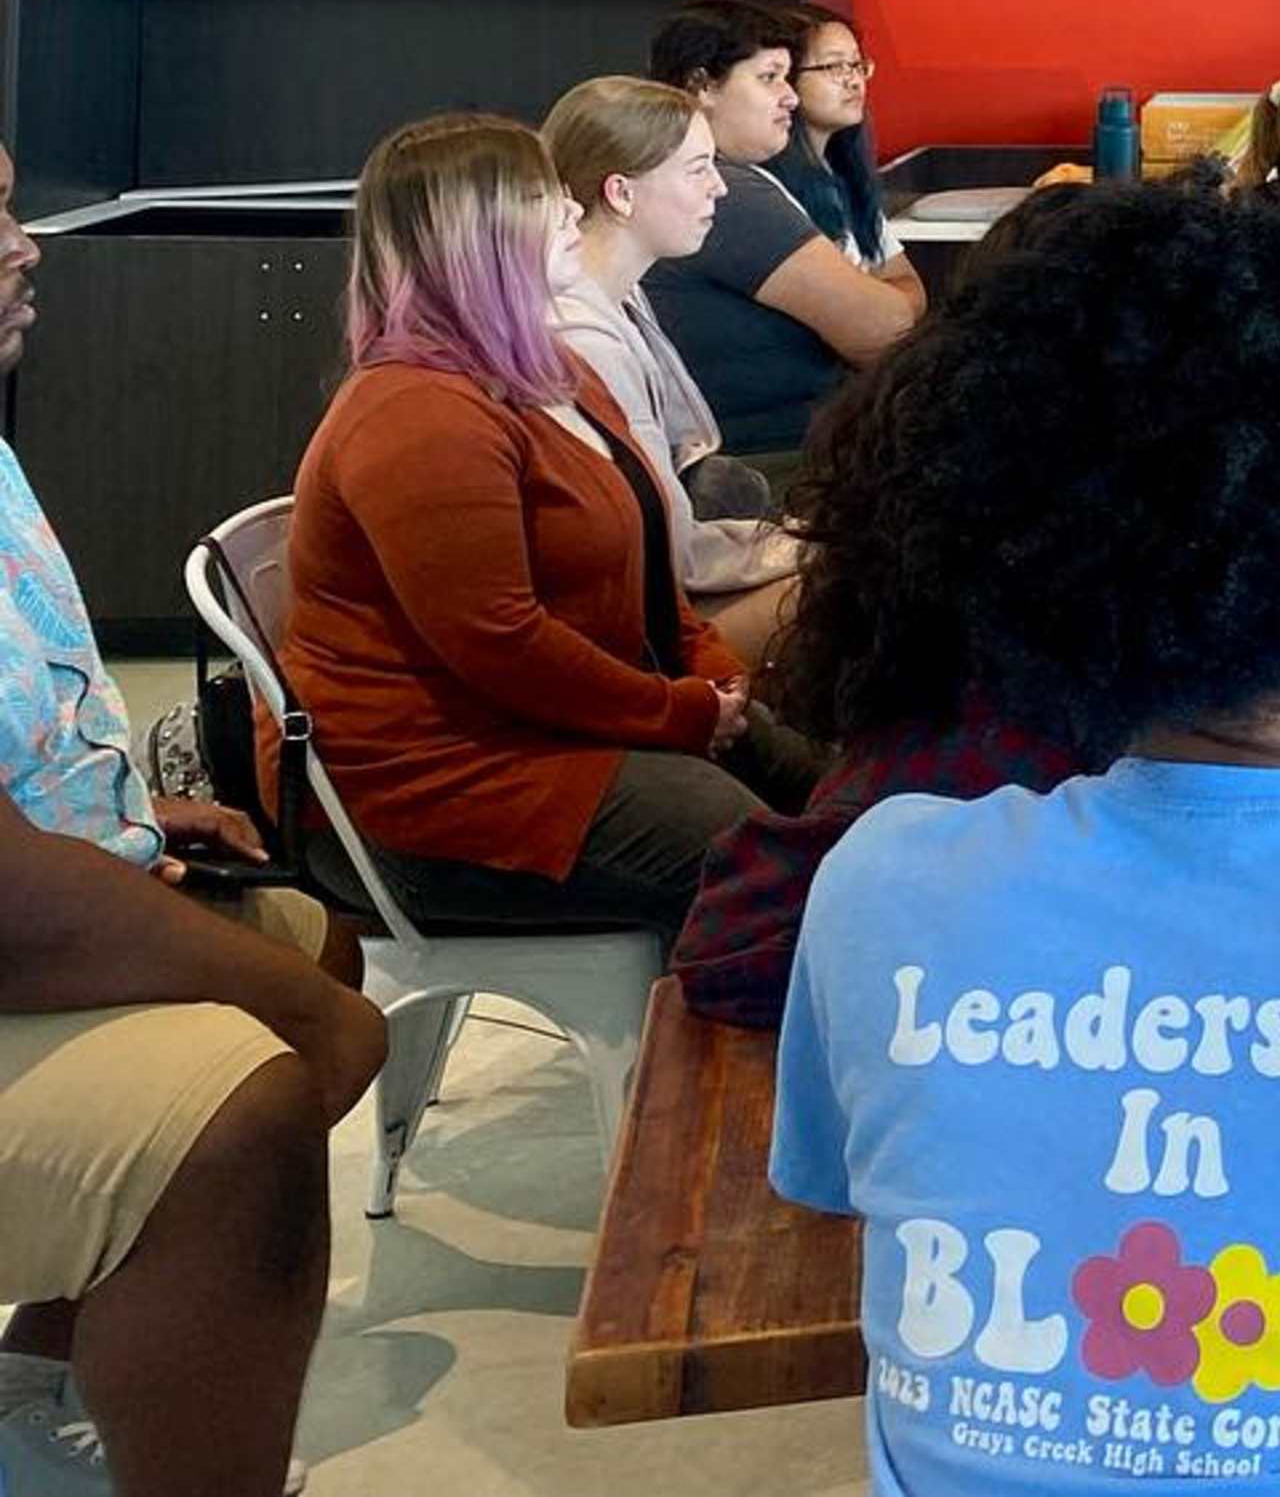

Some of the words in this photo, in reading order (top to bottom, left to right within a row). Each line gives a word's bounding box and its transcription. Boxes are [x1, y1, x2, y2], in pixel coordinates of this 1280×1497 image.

[1104, 1088, 1230, 1198] In
[877, 1356, 931, 1413] 2023
[949, 1375, 1063, 1432] NCASC
[1086, 1393, 1197, 1447] State
[951, 1421, 1015, 1456] Grays
[1023, 1433, 1095, 1466] Creek
[1102, 1441, 1166, 1478] High
[1174, 1451, 1263, 1477] School
